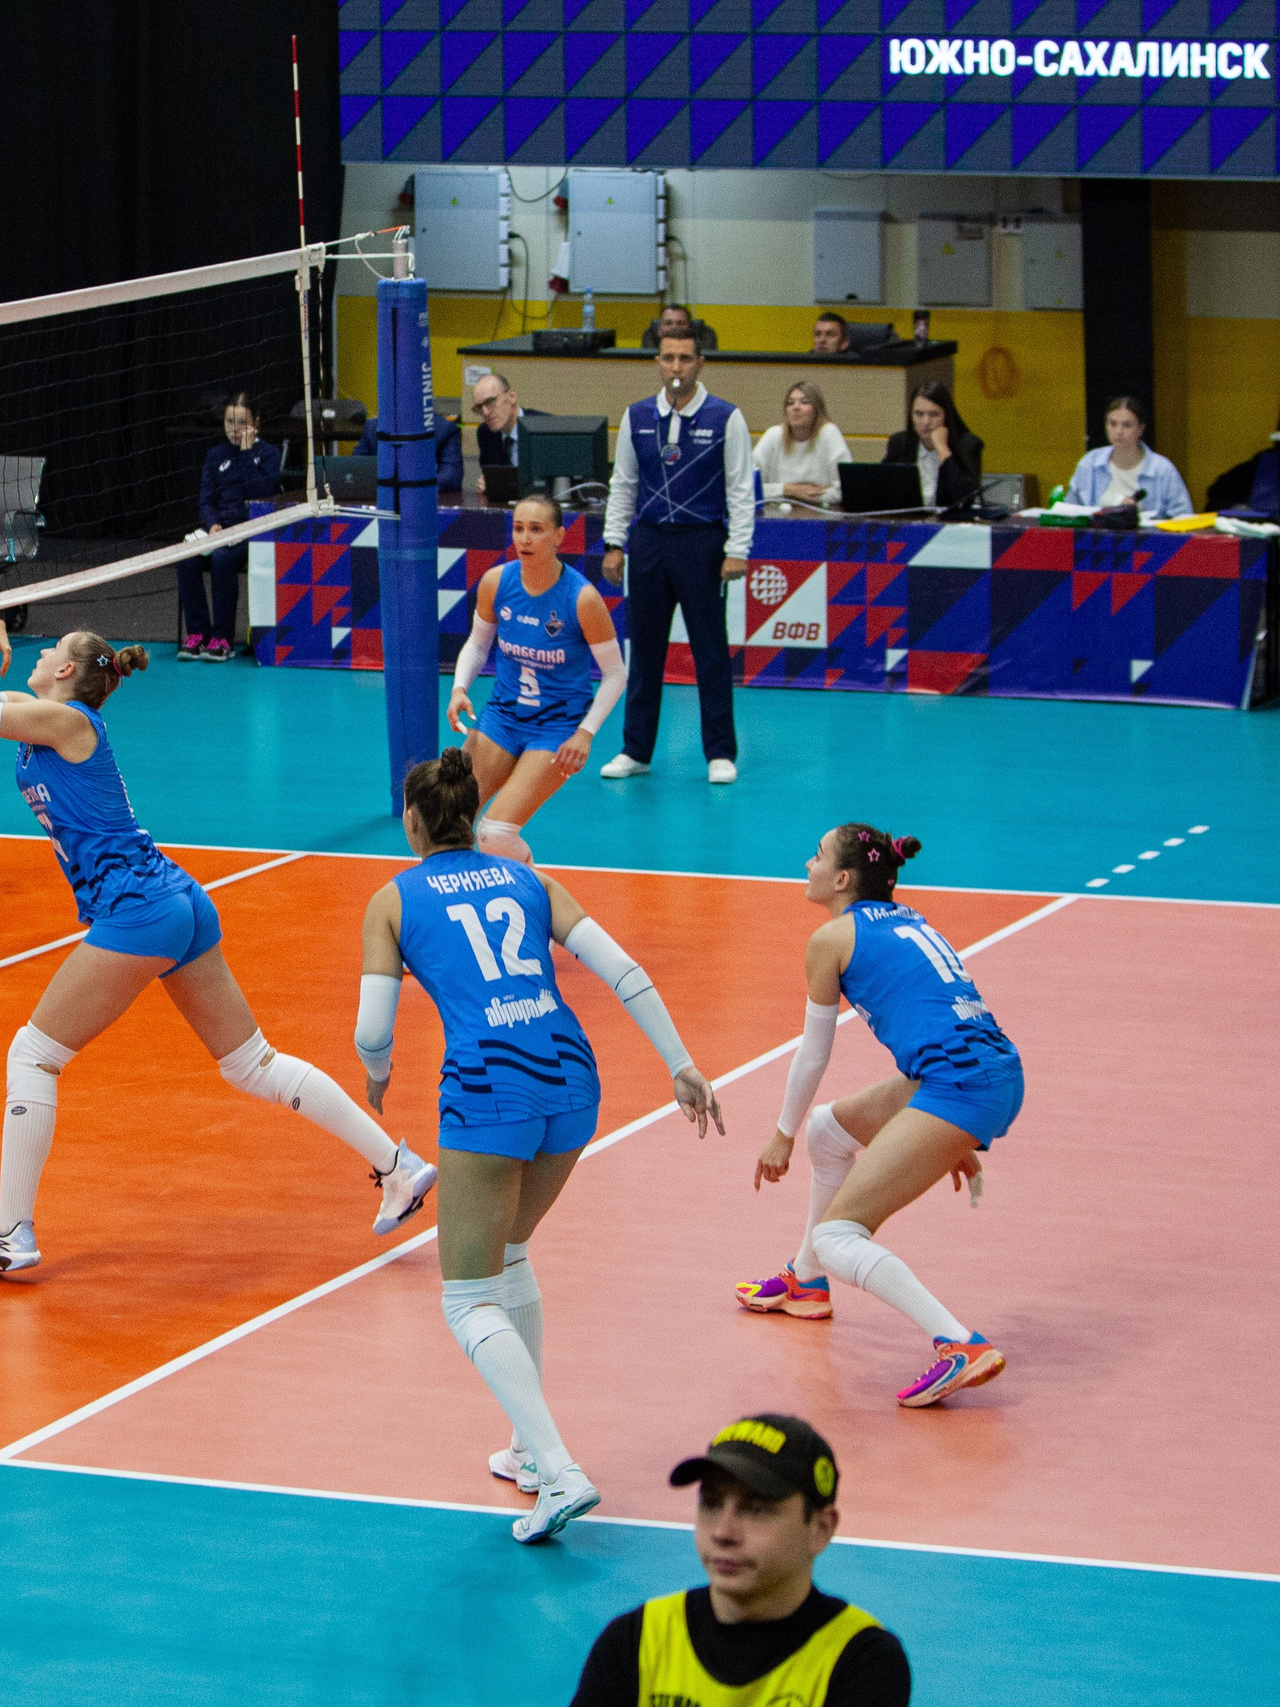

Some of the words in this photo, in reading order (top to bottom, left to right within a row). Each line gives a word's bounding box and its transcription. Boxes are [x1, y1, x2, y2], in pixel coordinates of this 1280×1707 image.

[889, 39, 1270, 79] ЮЖНО-САХАЛИНСК
[422, 362, 434, 430] JINLIN
[773, 622, 820, 641] ВФВ
[518, 666, 541, 698] 5
[426, 866, 516, 895] ЧЕРНЯЕВА
[446, 896, 543, 982] 12
